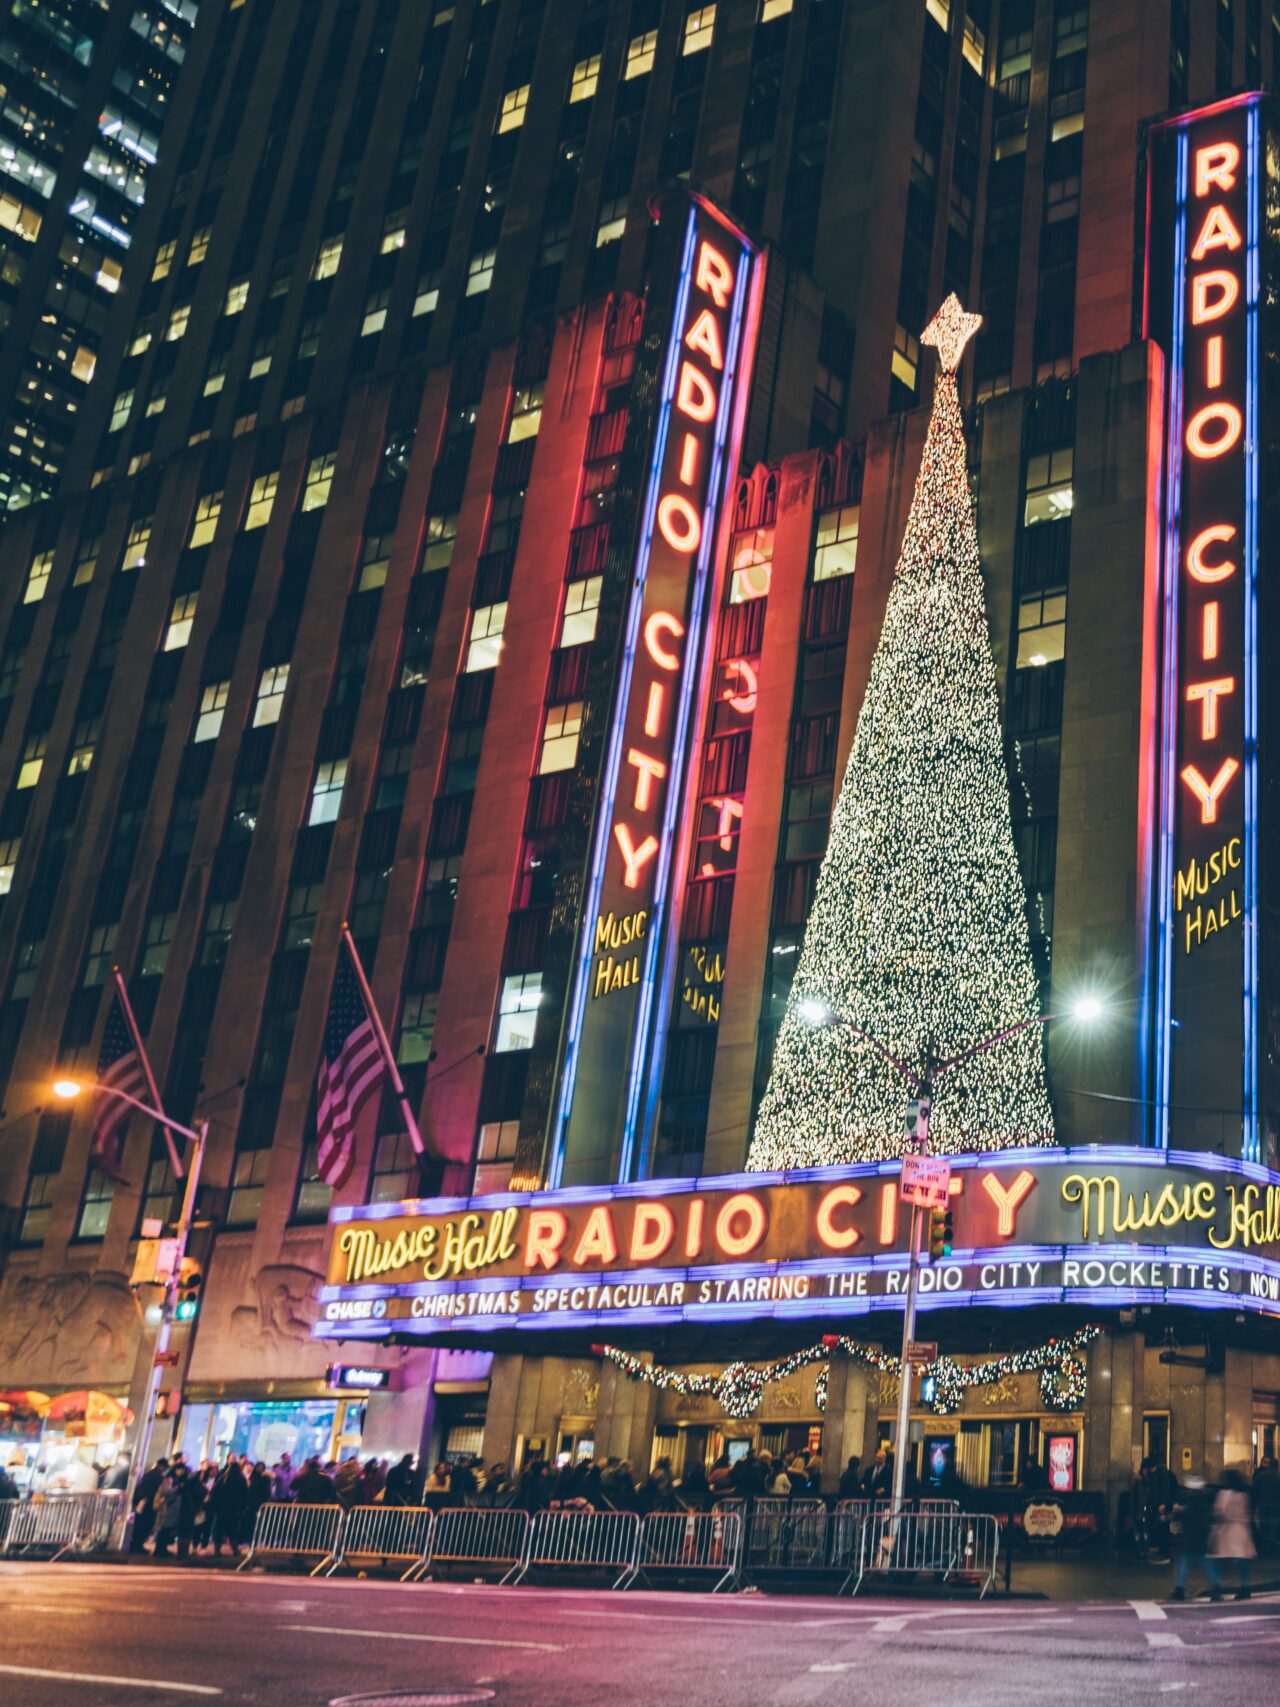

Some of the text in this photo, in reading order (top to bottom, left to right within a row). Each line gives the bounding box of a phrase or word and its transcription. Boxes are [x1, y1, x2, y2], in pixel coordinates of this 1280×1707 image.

[1180, 140, 1243, 824] RADIO CITY
[613, 240, 734, 889] RADIO CITY
[339, 1206, 520, 1283] Music Hall
[525, 1169, 1036, 1270] RADIO CIY
[1061, 1173, 1217, 1240] Music
[326, 1300, 372, 1320] CHASE
[411, 1290, 520, 1318] CHRISTMAS
[532, 1281, 685, 1311] SPECTACULAR
[700, 1274, 810, 1304] STARRING
[828, 1272, 868, 1296] THE
[885, 1266, 963, 1294] RADIO
[980, 1260, 1042, 1288] CITY
[1062, 1260, 1231, 1291] ROCKETTES
[1249, 1273, 1279, 1300] NOW
